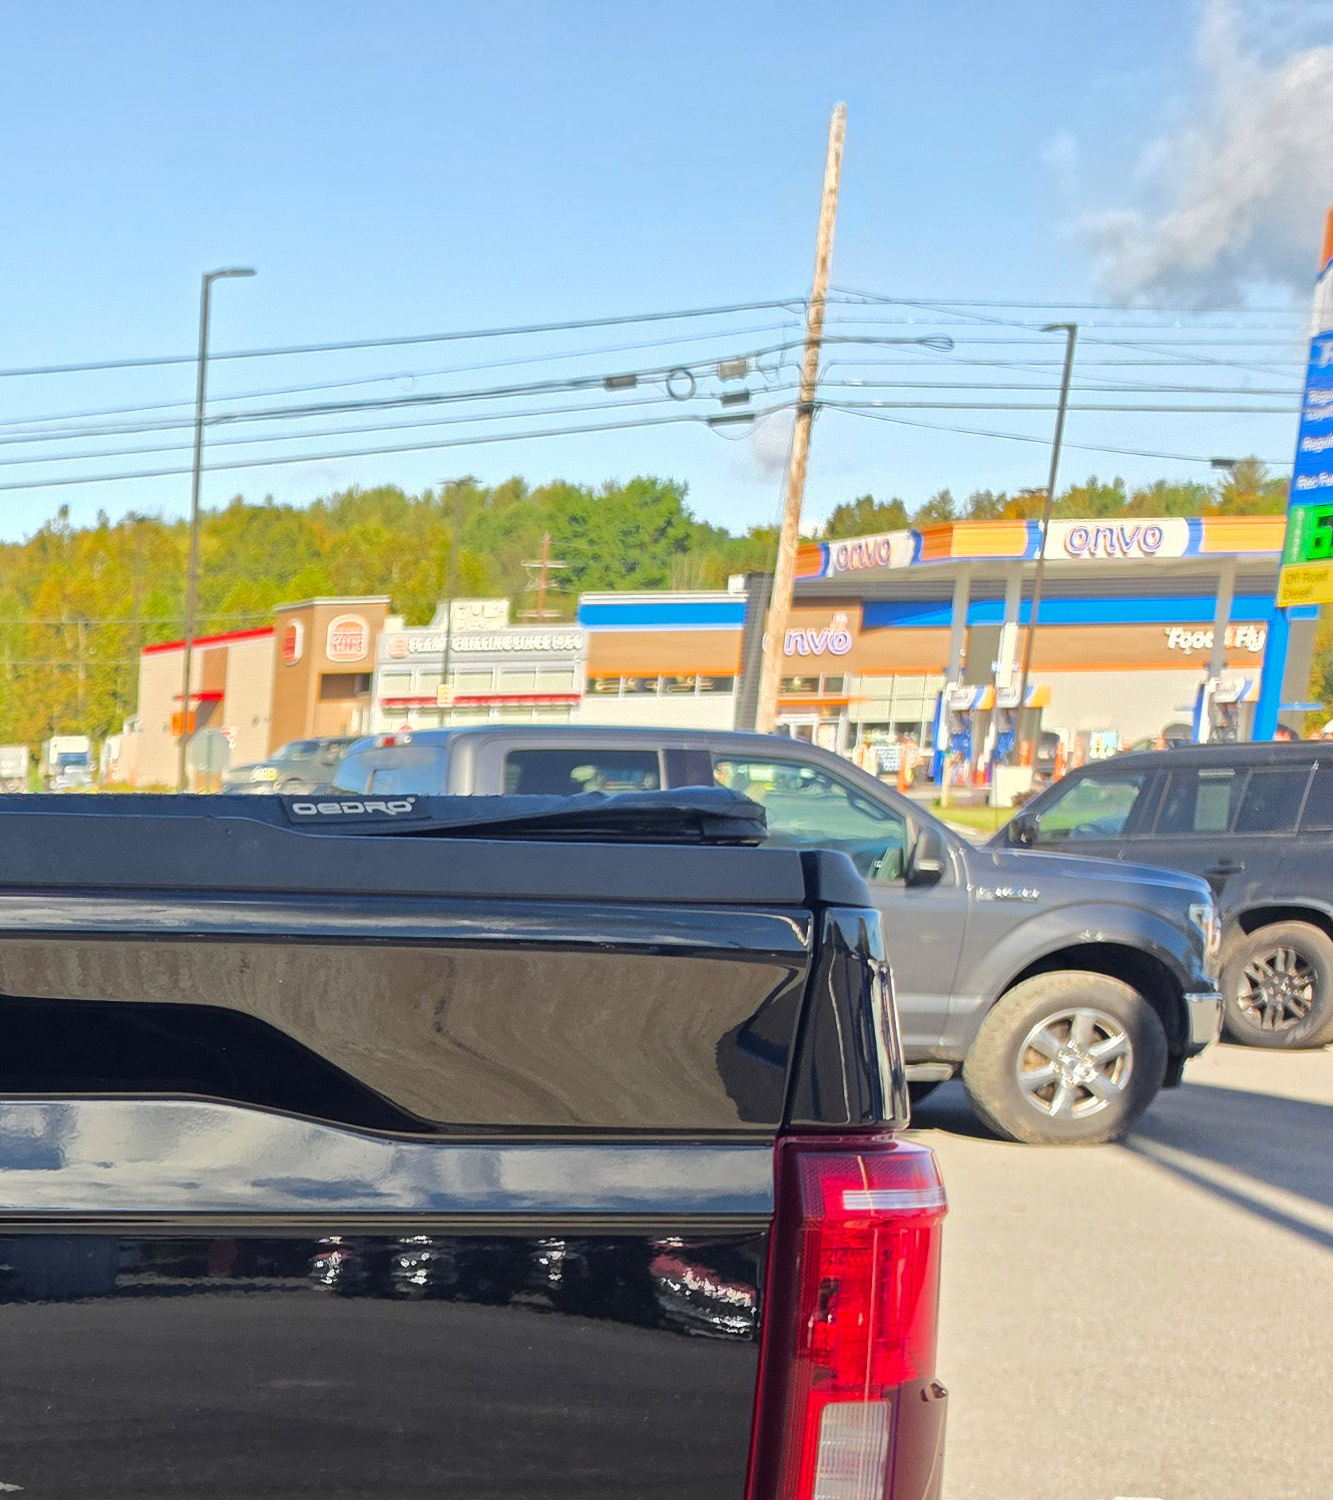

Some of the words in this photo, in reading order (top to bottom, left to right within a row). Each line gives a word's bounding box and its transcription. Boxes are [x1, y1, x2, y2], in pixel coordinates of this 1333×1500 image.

[836, 538, 892, 571] onvo
[1064, 525, 1164, 555] onvo
[762, 627, 853, 656] nvo
